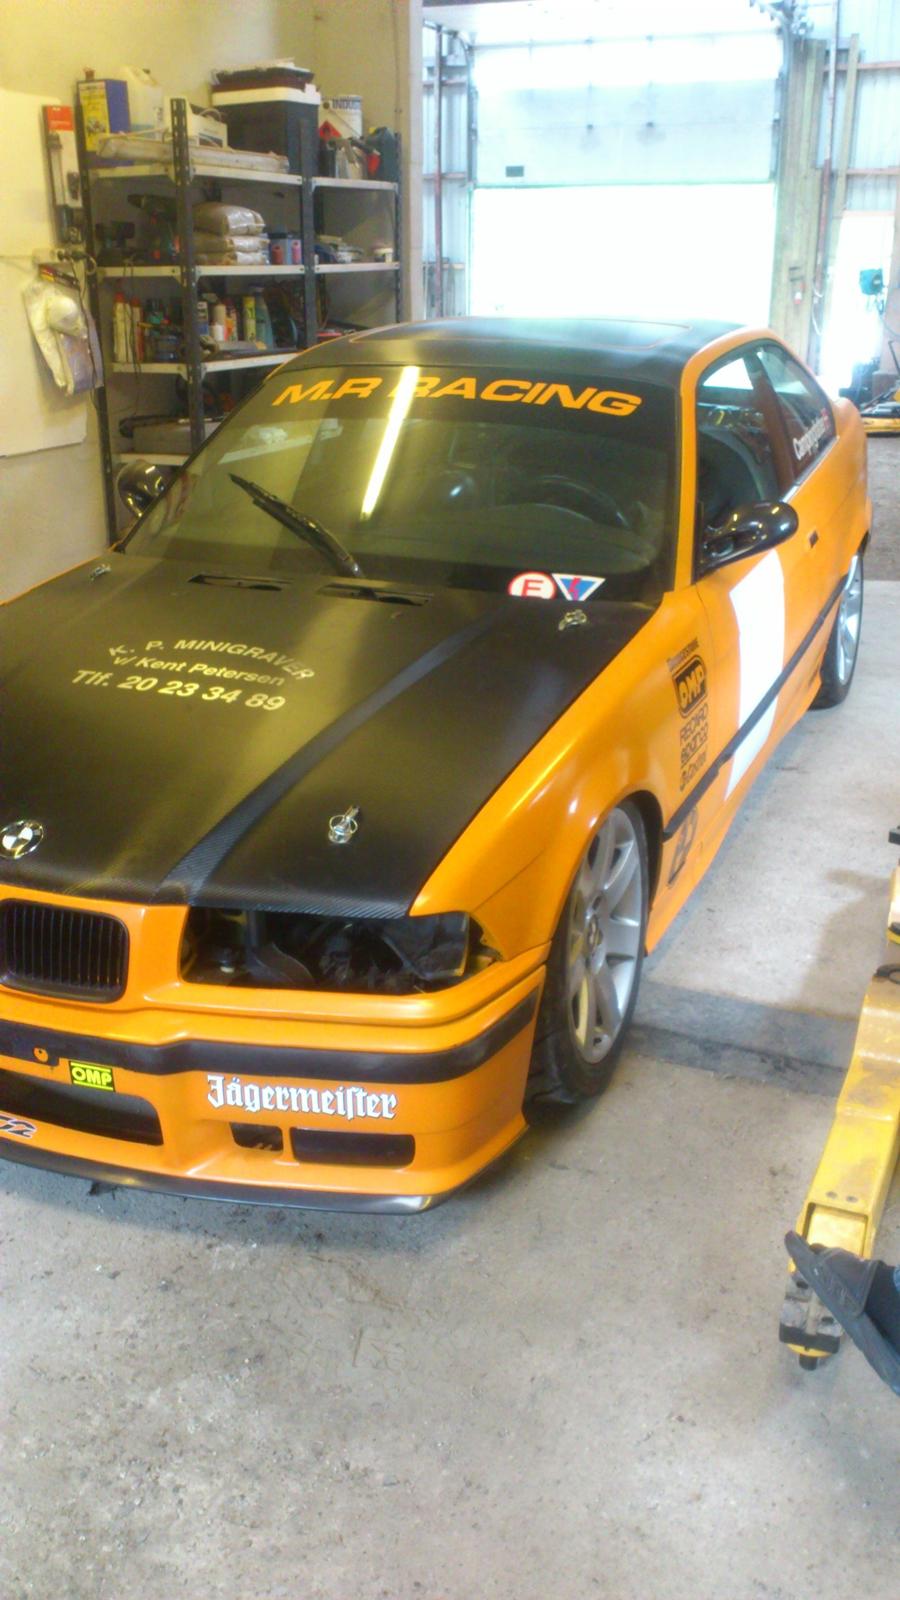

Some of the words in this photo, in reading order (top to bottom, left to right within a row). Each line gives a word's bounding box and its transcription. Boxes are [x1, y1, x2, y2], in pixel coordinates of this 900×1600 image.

[271, 377, 382, 406] M.R
[389, 376, 642, 416] RACING
[135, 657, 187, 672] Kent
[188, 663, 285, 687] Petersen
[146, 640, 164, 651] P.
[173, 639, 315, 680] MINIGRAVER
[116, 675, 158, 691] 20
[157, 680, 200, 697] 23
[202, 686, 242, 703] 34
[244, 693, 286, 711] 89
[71, 1066, 112, 1086] OMP
